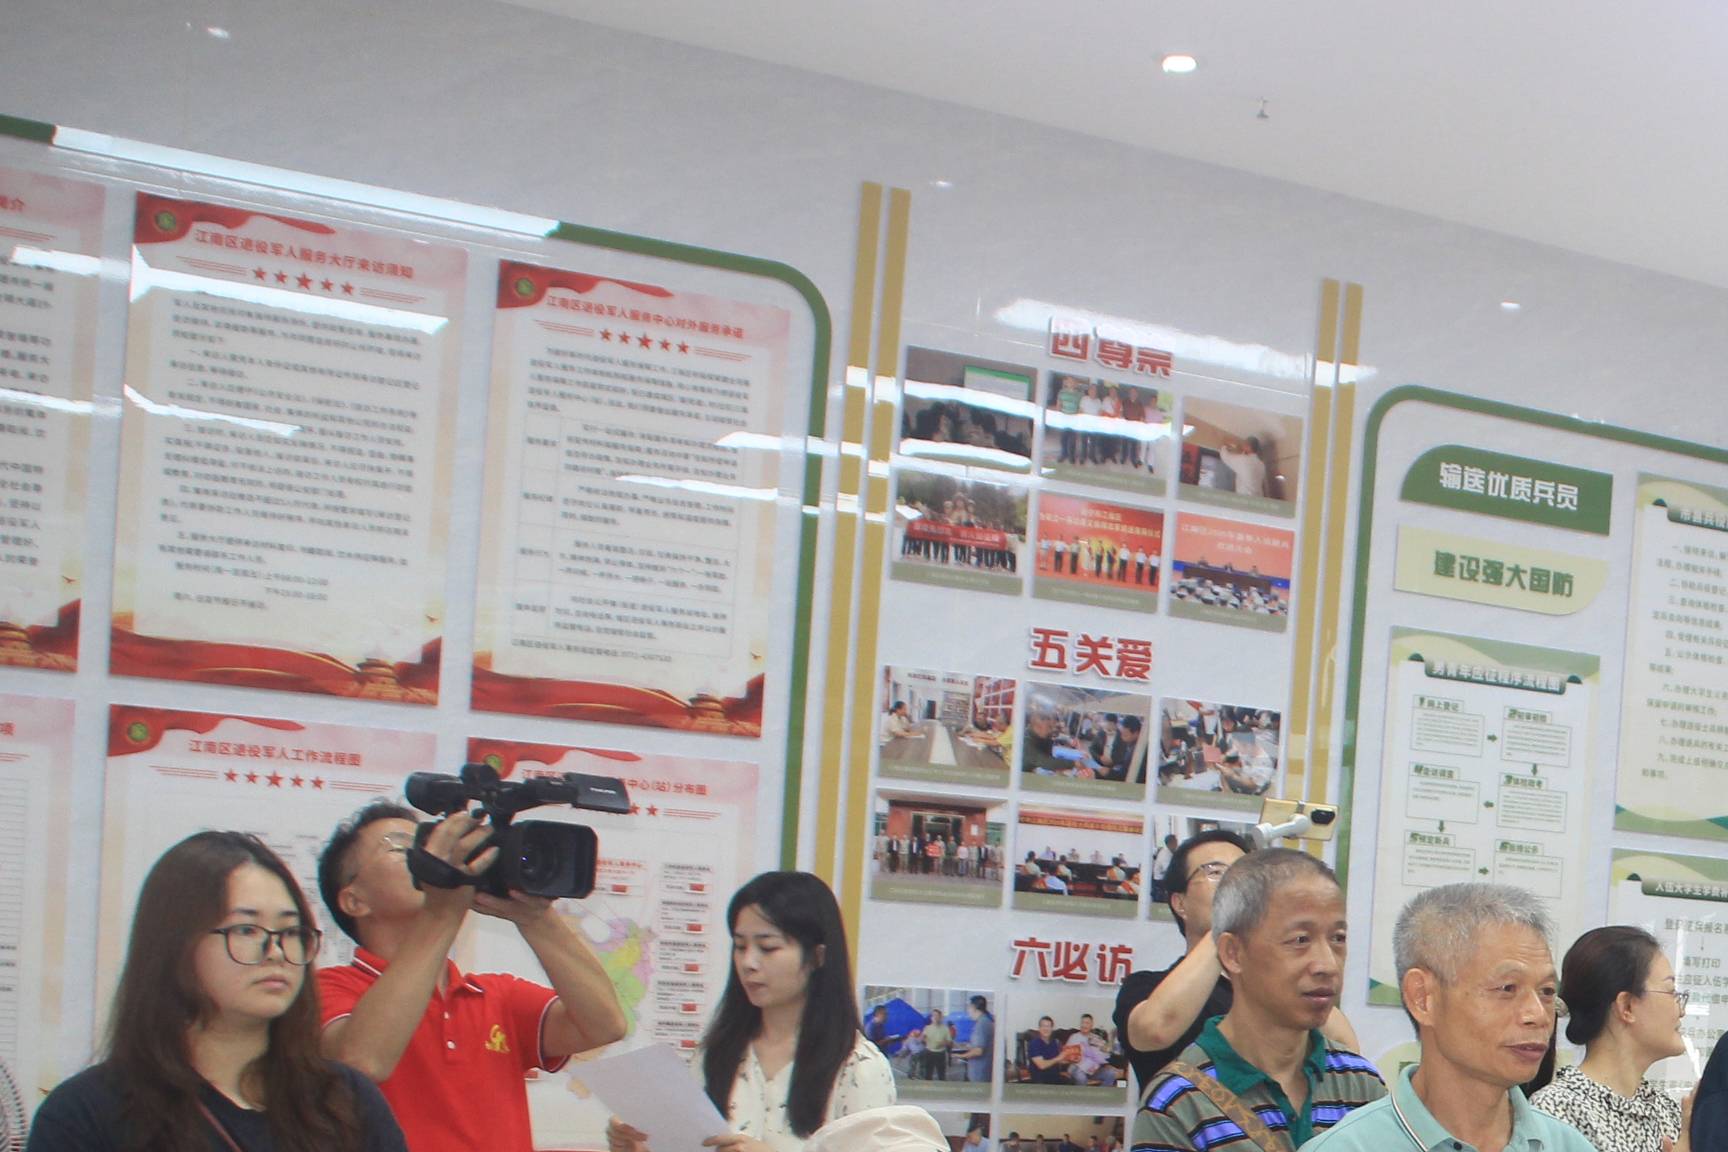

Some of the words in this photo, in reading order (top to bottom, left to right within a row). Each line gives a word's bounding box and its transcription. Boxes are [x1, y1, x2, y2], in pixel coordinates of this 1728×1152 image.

[195, 230, 415, 279] 江南区退役军人服务大厅来访须知
[547, 295, 744, 340] 江南区退役军人服务中心对外服务承诺
[1439, 462, 1579, 511] 输送优质兵员
[1433, 550, 1574, 598] 建设强大国防
[1030, 627, 1154, 681] 五关爱
[189, 739, 362, 767] 江南区退役军人工作流程图
[1012, 937, 1133, 985] 六必访
